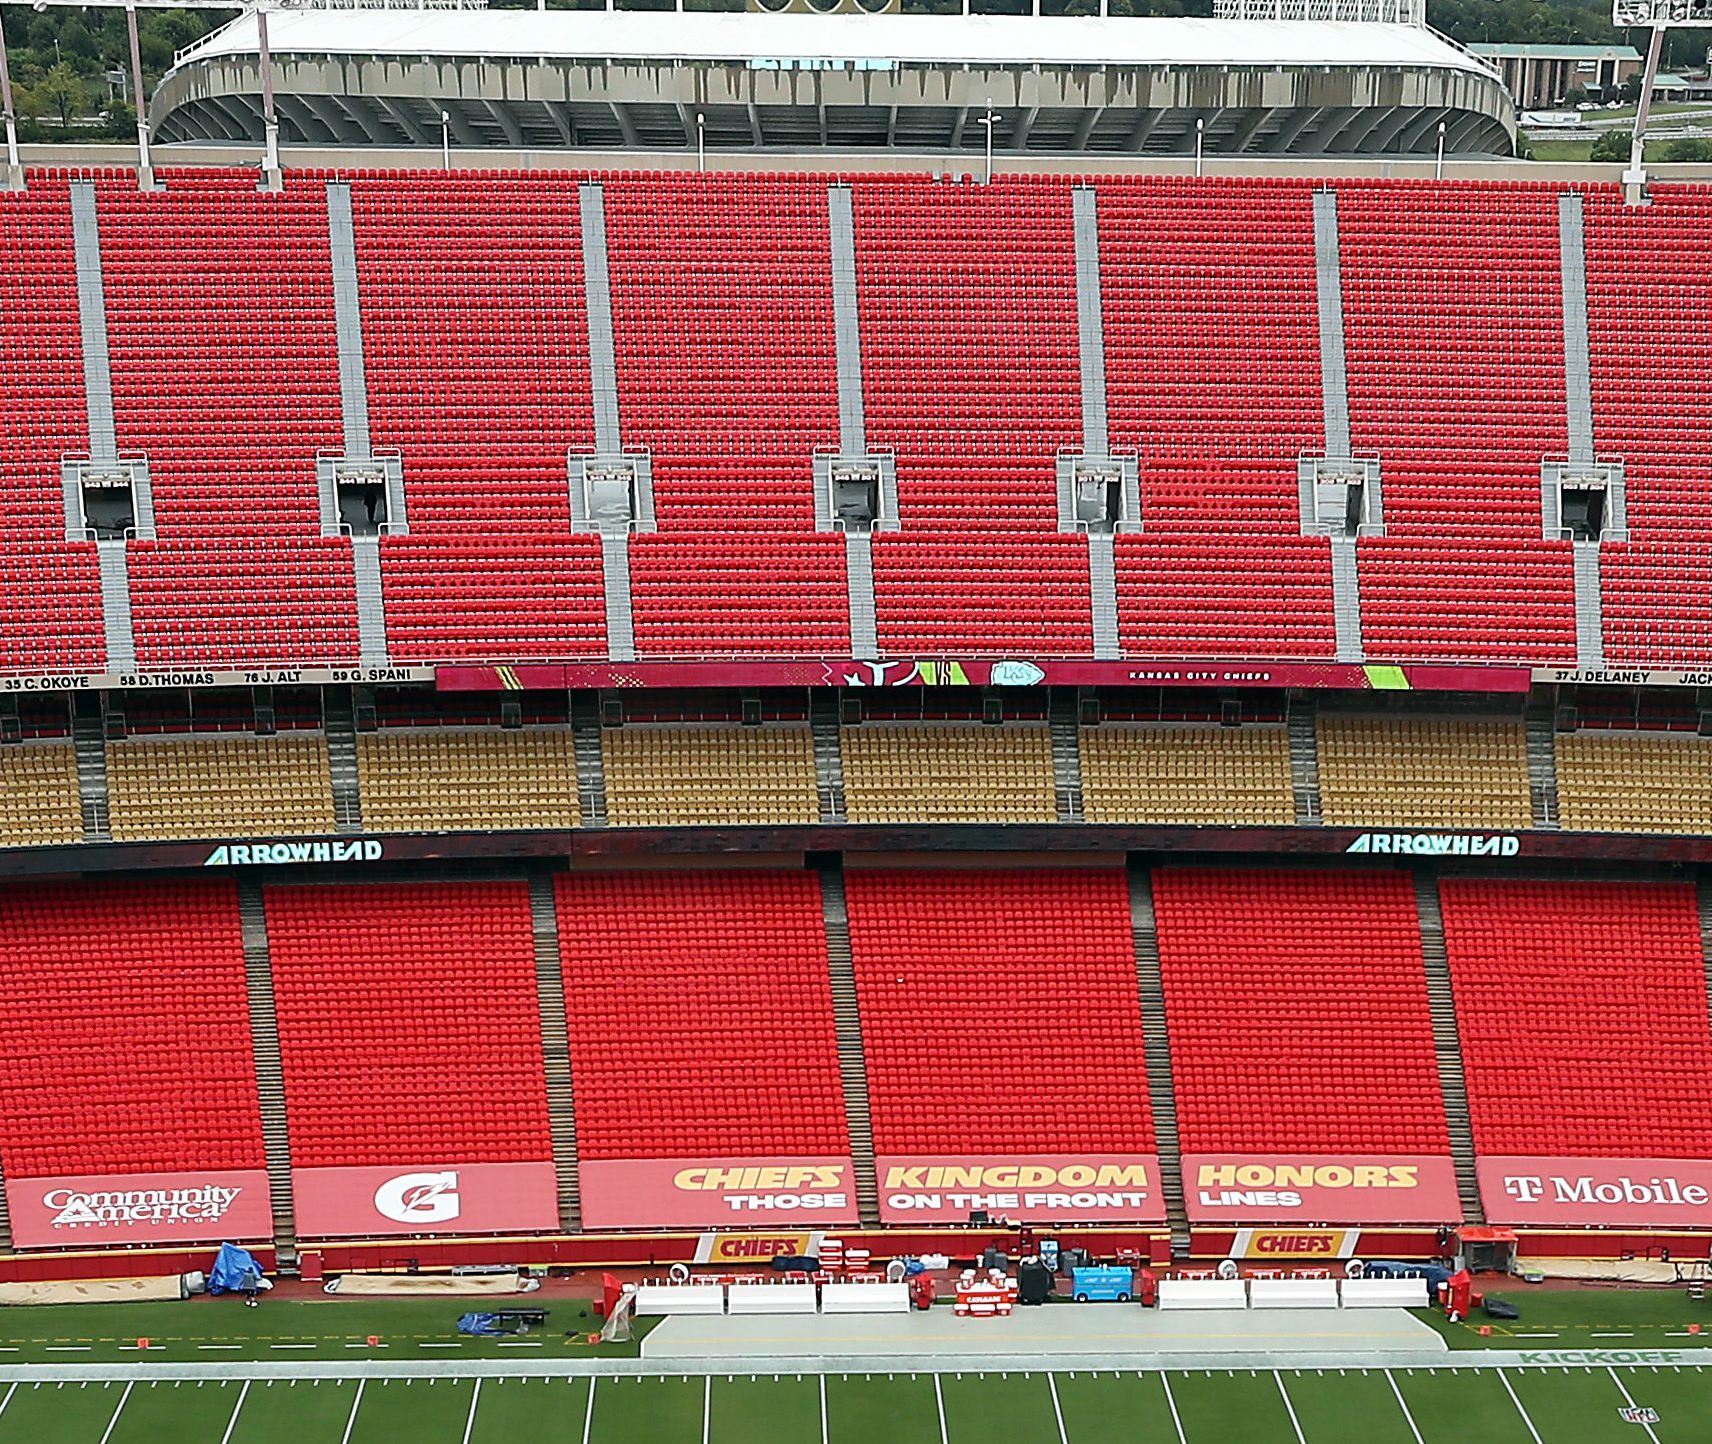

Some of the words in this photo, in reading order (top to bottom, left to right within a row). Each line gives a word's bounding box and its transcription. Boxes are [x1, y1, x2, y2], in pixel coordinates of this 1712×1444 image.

[5, 680, 21, 689] 35
[25, 679, 38, 689] C.
[41, 677, 89, 689] OKOYE
[333, 672, 347, 680] 59
[351, 670, 365, 681] G.
[369, 669, 410, 680] SPANI
[1129, 672, 1180, 680] KANSAS
[1187, 672, 1217, 680] CITY
[1223, 672, 1270, 681] CHIEFS
[203, 840, 383, 865] ARROWHEAD
[1345, 834, 1520, 856] ARROWHEAD
[673, 1165, 846, 1191] CHIEFS
[885, 1165, 1149, 1189] KINGDOM
[1197, 1165, 1419, 1188] HONORS
[42, 1184, 245, 1211] Community
[724, 1193, 847, 1209] THOSE
[888, 1193, 941, 1209] ON
[942, 1193, 1023, 1208] THE
[1025, 1193, 1148, 1208] FRONT
[1199, 1191, 1302, 1207] LINES
[1554, 1176, 1709, 1205] Mobile
[719, 1236, 800, 1257] CHIEFS
[1255, 1233, 1334, 1254] CHIEFS
[1519, 1351, 1682, 1364] KICKOFF
